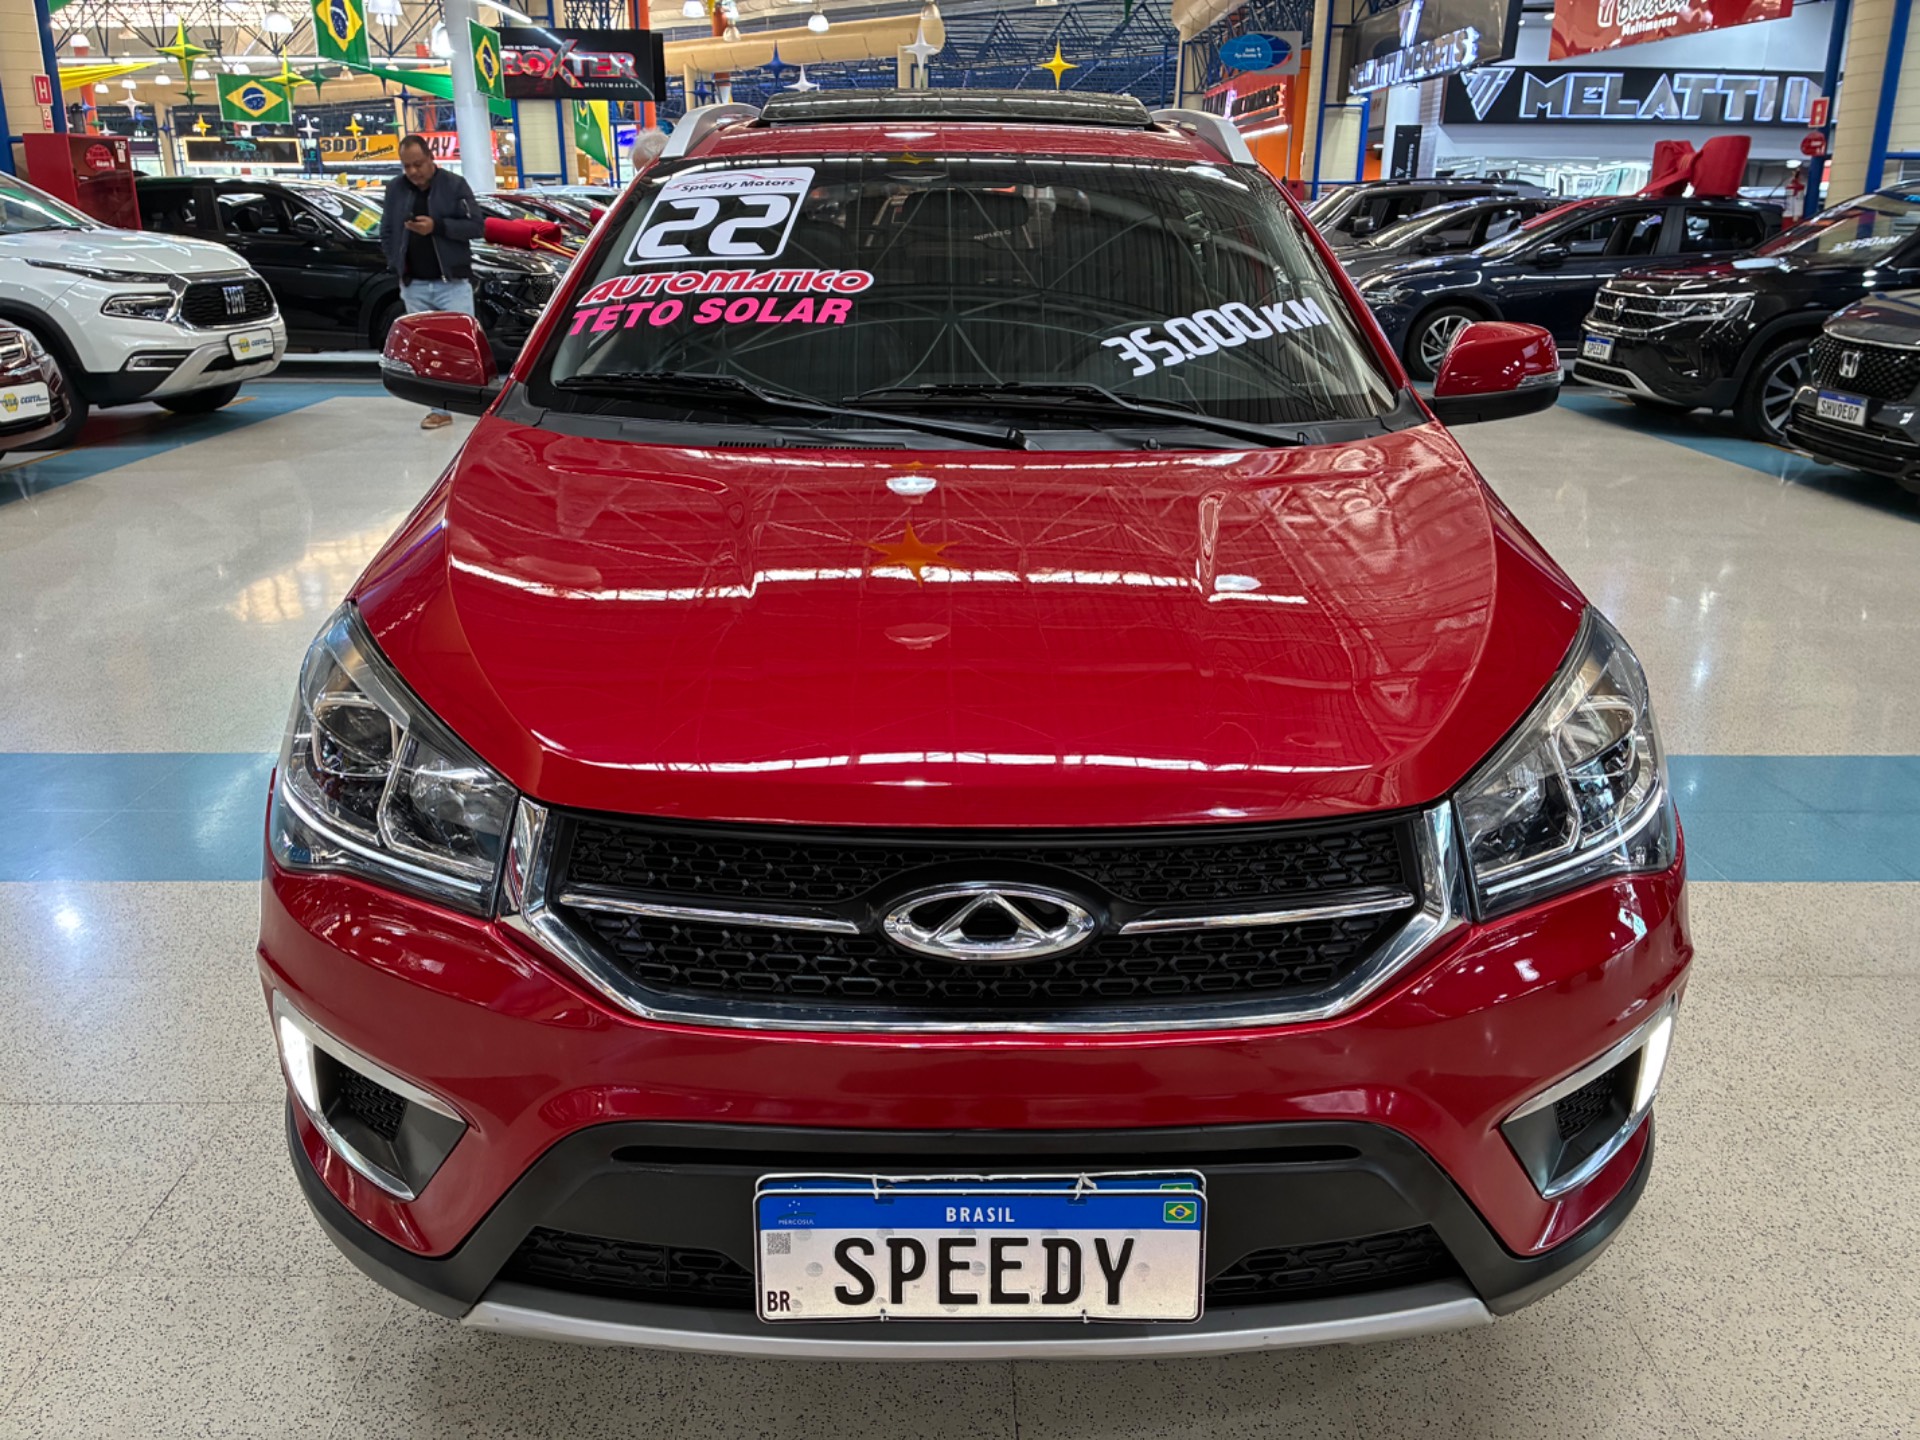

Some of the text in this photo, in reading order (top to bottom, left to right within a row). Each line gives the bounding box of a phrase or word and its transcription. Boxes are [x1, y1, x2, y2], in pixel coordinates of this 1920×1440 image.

[1622, 15, 1678, 36] Multimarcas
[500, 39, 639, 88] BOXTER
[680, 181, 737, 193] Speedy
[637, 194, 791, 258] 22
[222, 285, 246, 315] FIAT
[576, 269, 874, 307] AUTOMATICO
[569, 297, 852, 336] TETO SOLAR
[946, 1206, 1015, 1223] BRASIL
[834, 1237, 1134, 1305] SPEEDY
[766, 1290, 791, 1312] BR
